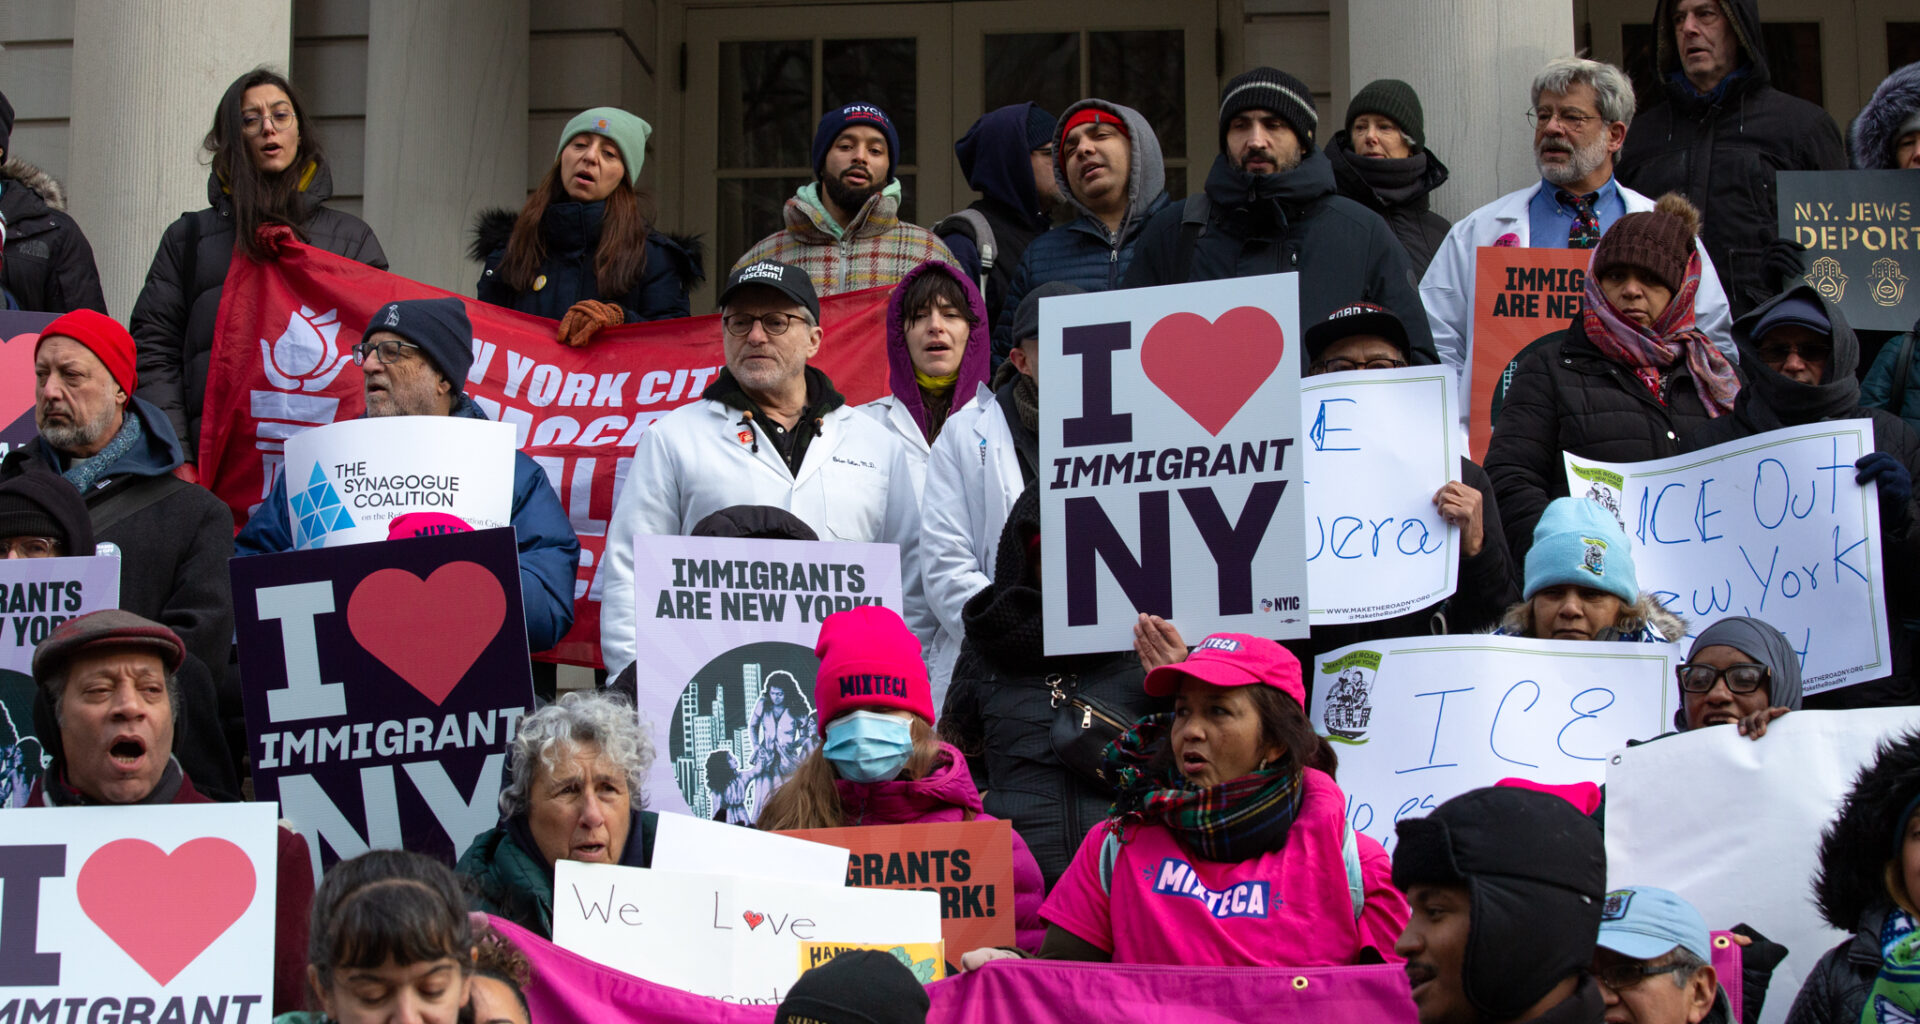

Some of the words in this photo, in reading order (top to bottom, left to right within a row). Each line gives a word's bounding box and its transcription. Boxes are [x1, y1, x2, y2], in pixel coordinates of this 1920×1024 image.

[1795, 202, 1839, 221] N.Y.
[1845, 202, 1911, 221] JEWS
[1493, 293, 1540, 318] ARE
[1546, 295, 1586, 319] NE
[503, 349, 631, 407] YORK
[1062, 321, 1133, 448] I
[335, 461, 366, 479] THE
[1050, 438, 1294, 490] IMMIGRANT
[344, 474, 460, 494] SYNAGOGUE
[353, 490, 454, 509] COALITION
[1636, 478, 1723, 545] ICE
[1065, 480, 1288, 627] NY
[672, 558, 866, 593] IMMIGRANTS
[656, 590, 712, 620] ARE
[721, 592, 787, 622] NEW
[1274, 597, 1300, 612] NYIC
[1326, 594, 1431, 615] WWW.MAKETHEROADNY.ORG
[255, 580, 347, 722] I
[839, 674, 907, 699] MIXTECA
[258, 707, 525, 769] IMMIGRANT
[1395, 680, 1615, 774] ICE
[572, 883, 643, 926] We
[920, 884, 996, 920] RK!
[1157, 860, 1265, 917] MIXTECA
